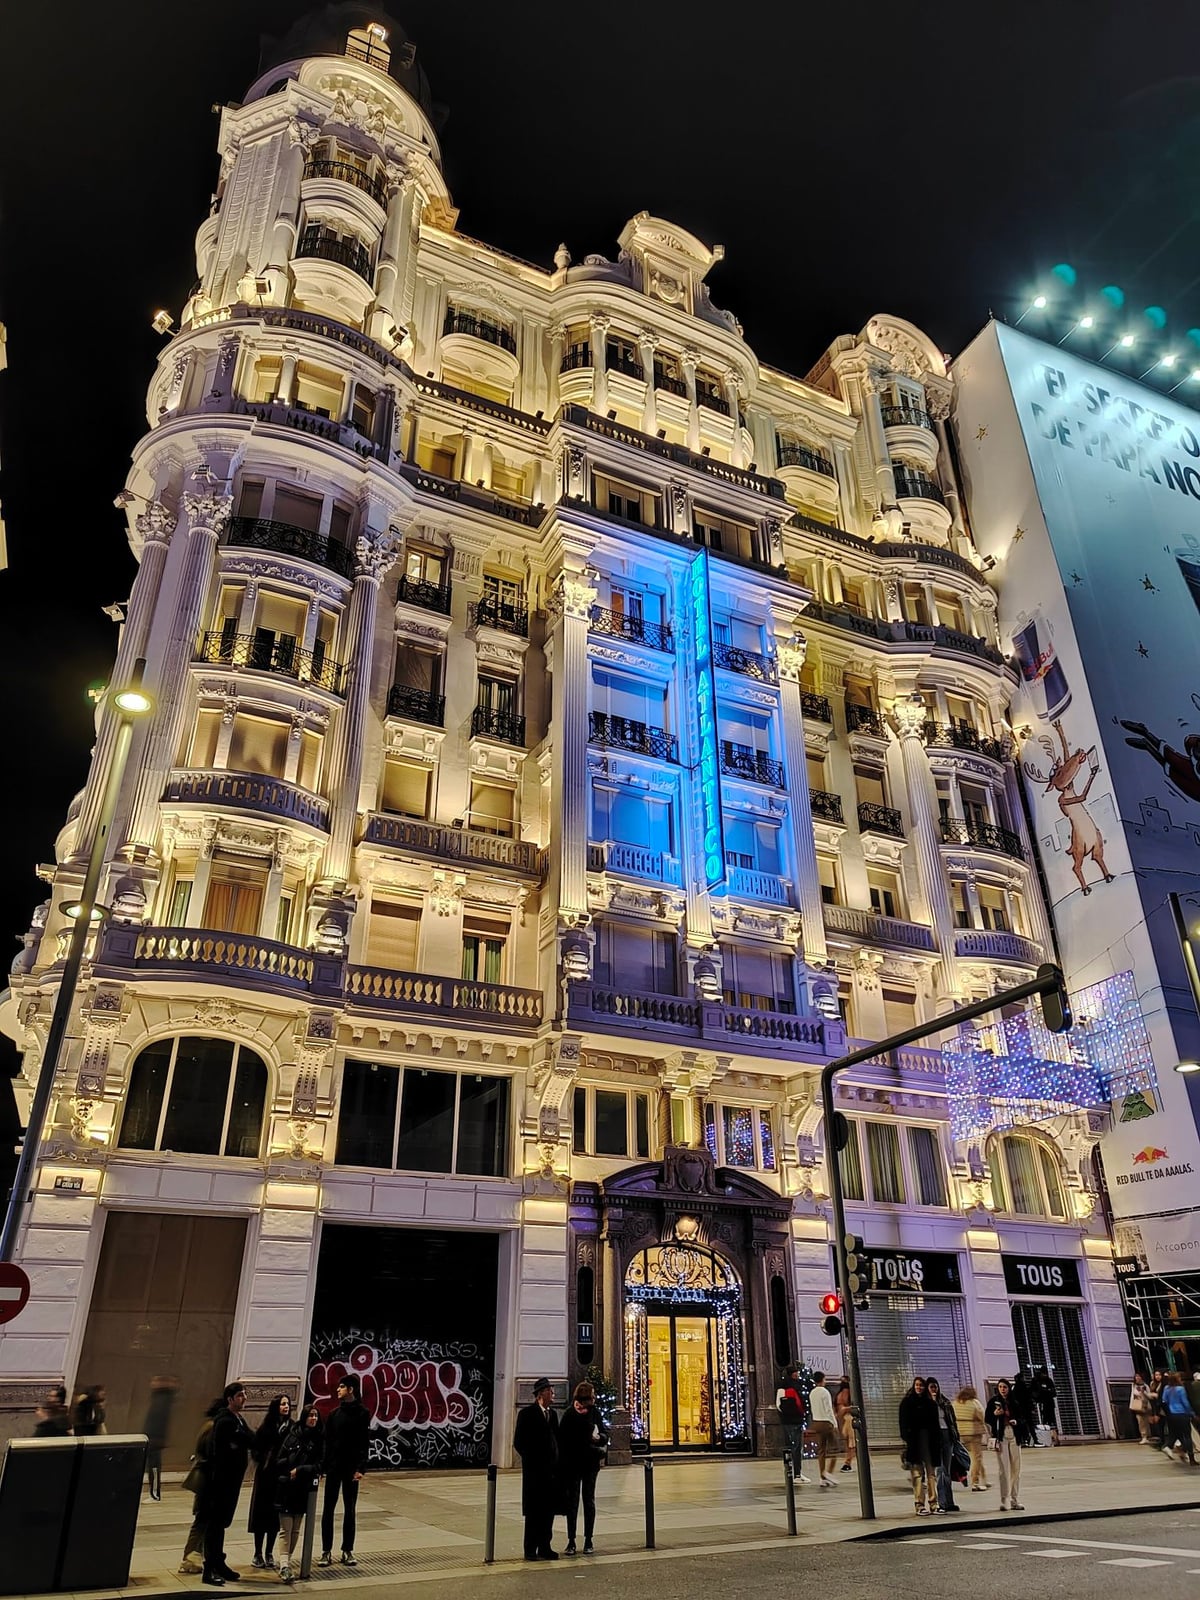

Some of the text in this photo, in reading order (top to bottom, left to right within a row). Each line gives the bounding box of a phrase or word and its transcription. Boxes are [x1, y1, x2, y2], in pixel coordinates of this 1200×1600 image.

[691, 552, 707, 660] HOTEL
[697, 670, 721, 880] ATLANTICO
[1116, 1174, 1129, 1186] RED
[1129, 1171, 1146, 1184] BULL
[1145, 1170, 1154, 1181] TE
[1154, 1168, 1165, 1180] DA
[1155, 1240, 1200, 1253] Arcopon
[873, 1258, 924, 1282] TOUS
[1016, 1264, 1064, 1288] TOUS
[1116, 1263, 1136, 1273] TOUS
[631, 1287, 666, 1299] HOTEL
